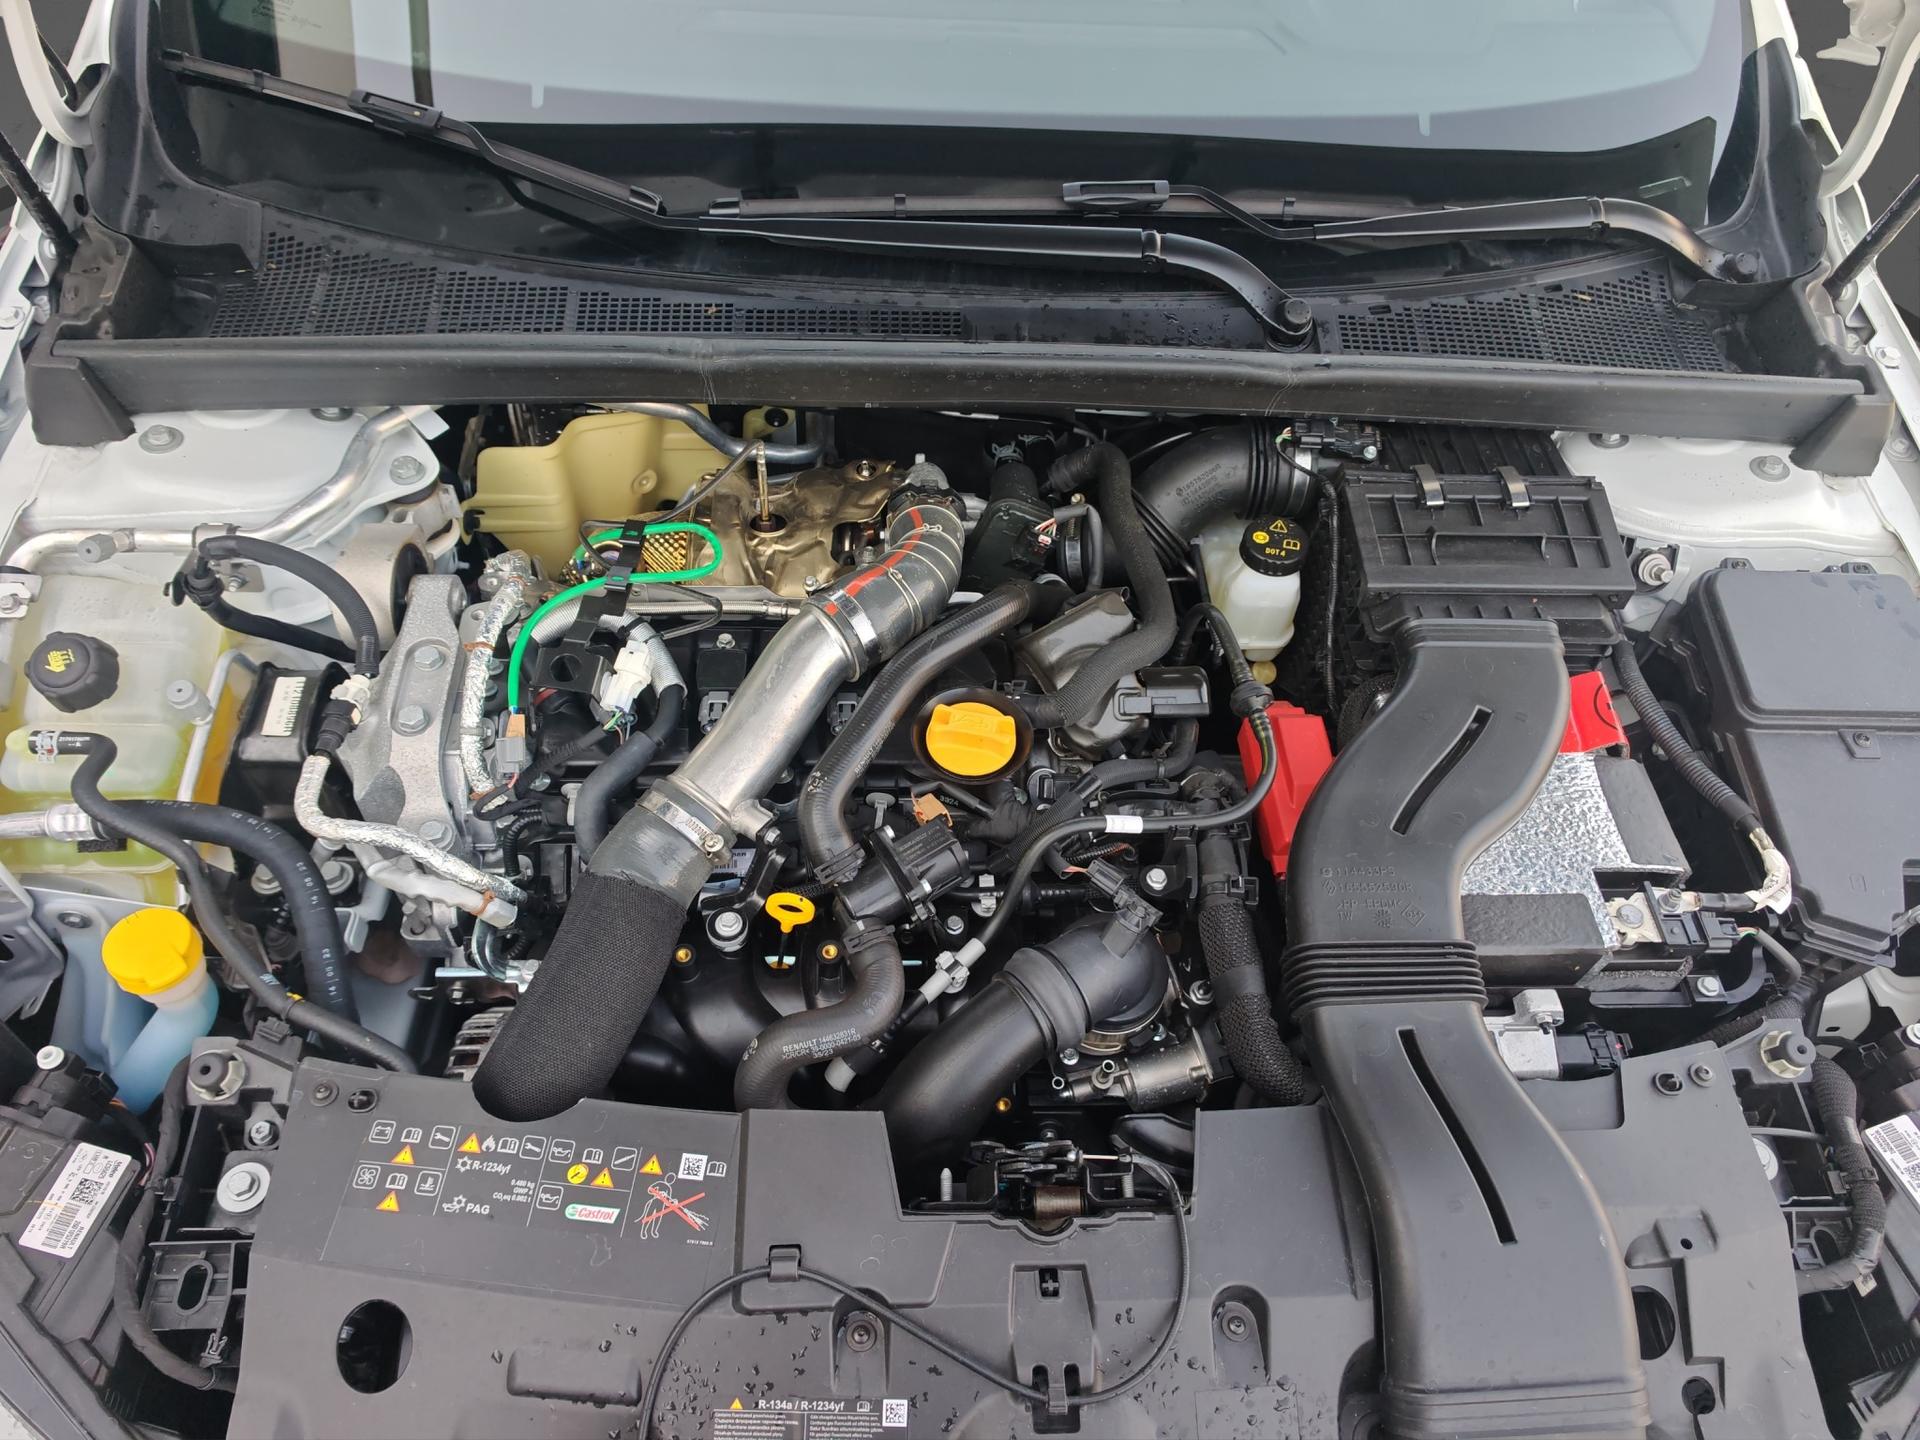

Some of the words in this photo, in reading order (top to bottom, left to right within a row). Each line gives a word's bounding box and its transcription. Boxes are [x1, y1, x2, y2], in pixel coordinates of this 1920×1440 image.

[1265, 547, 1280, 556] DOT
[783, 1039, 817, 1053] RENAULT
[472, 1160, 511, 1175] R-1234yf
[466, 1203, 490, 1214] PAG
[577, 1207, 614, 1221] Castrol
[759, 1399, 793, 1409] R-134a
[800, 1401, 845, 1413] R-1234yf
